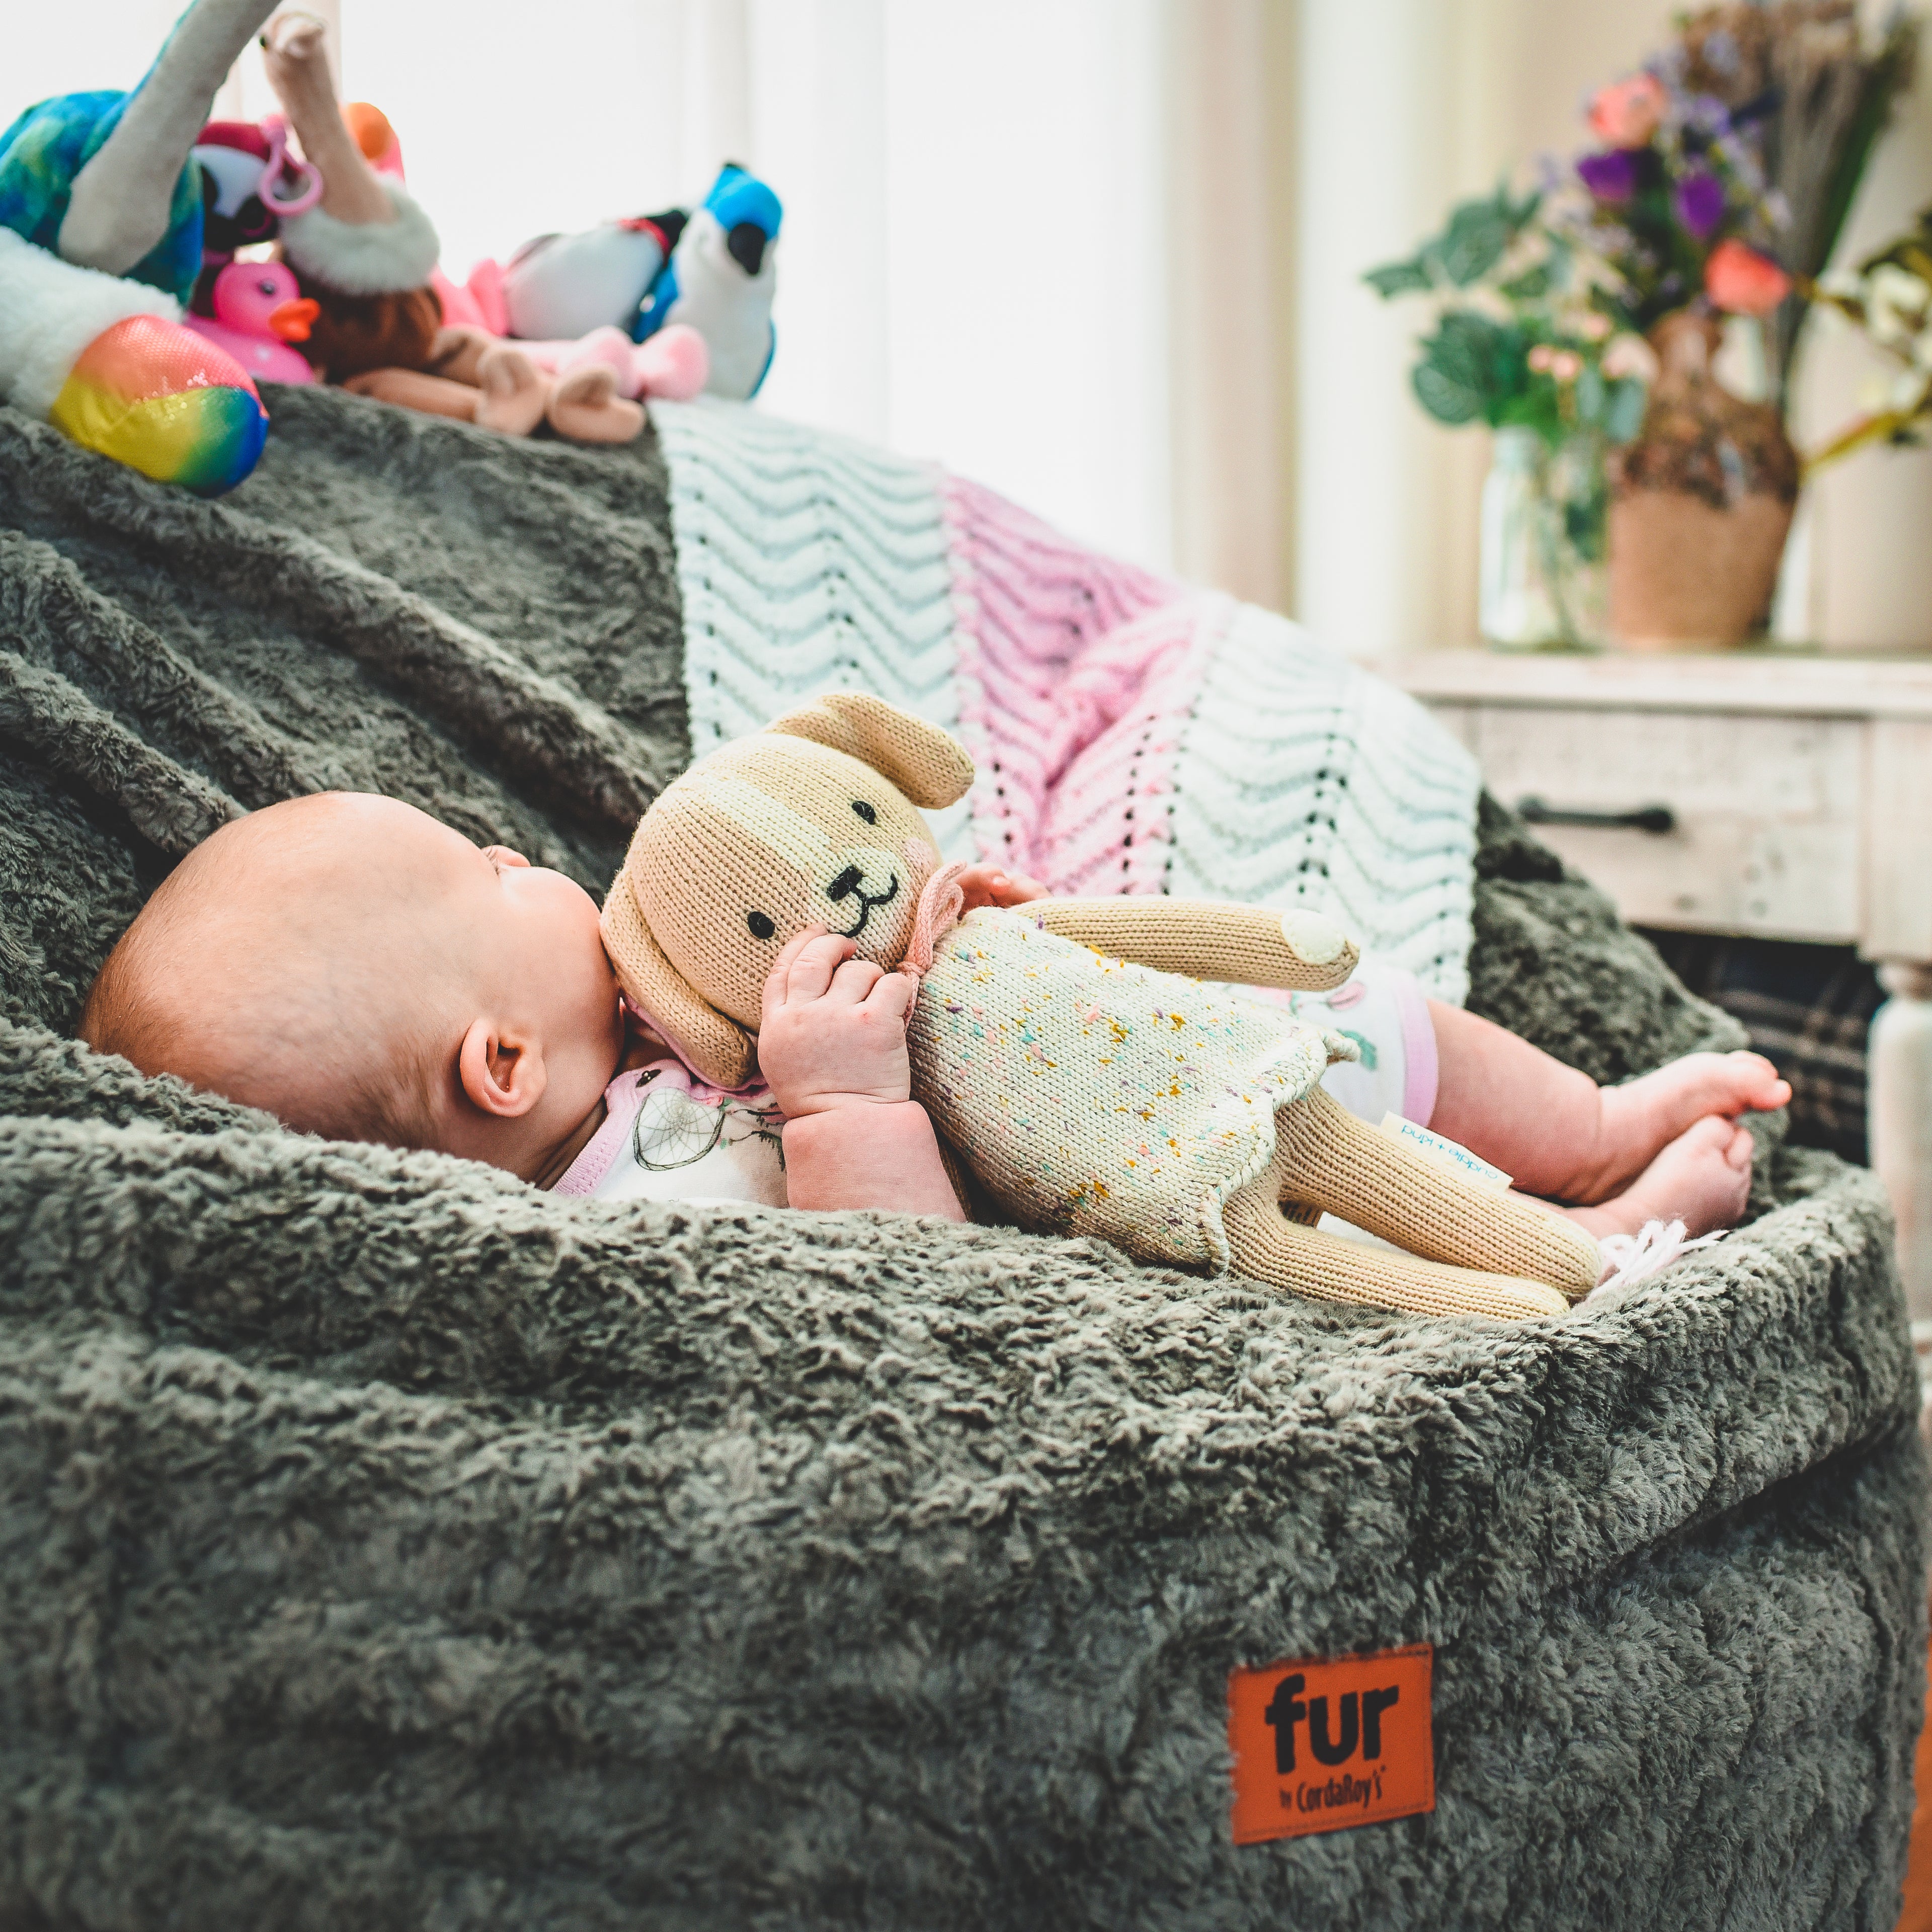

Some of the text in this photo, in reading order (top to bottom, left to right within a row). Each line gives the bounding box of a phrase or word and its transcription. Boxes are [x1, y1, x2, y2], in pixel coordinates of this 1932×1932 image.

[1402, 1125, 1433, 1146] kind
[1449, 1149, 1498, 1179] cuddle
[1265, 1673, 1399, 1775] fur
